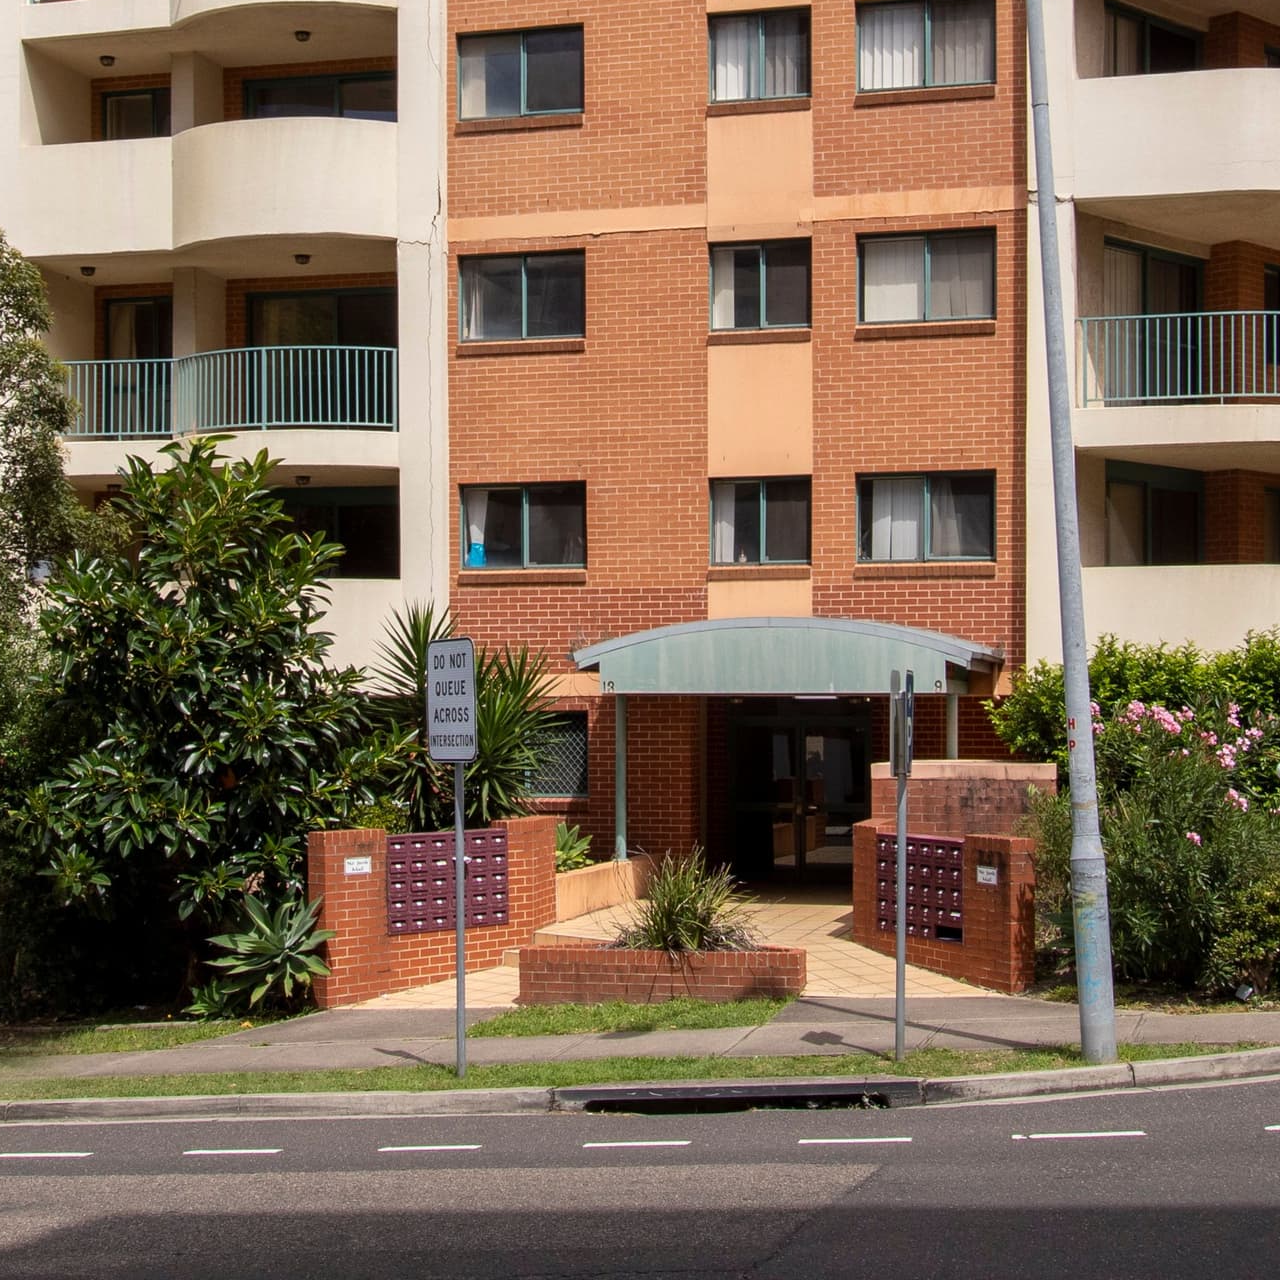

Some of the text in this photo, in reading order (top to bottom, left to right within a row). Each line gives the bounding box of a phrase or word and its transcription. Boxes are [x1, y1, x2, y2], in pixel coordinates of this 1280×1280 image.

[434, 653, 467, 670] DO NOT
[435, 680, 466, 696] QUEUE
[433, 707, 469, 723] ACROSS
[431, 734, 473, 747] INTERSECTION
